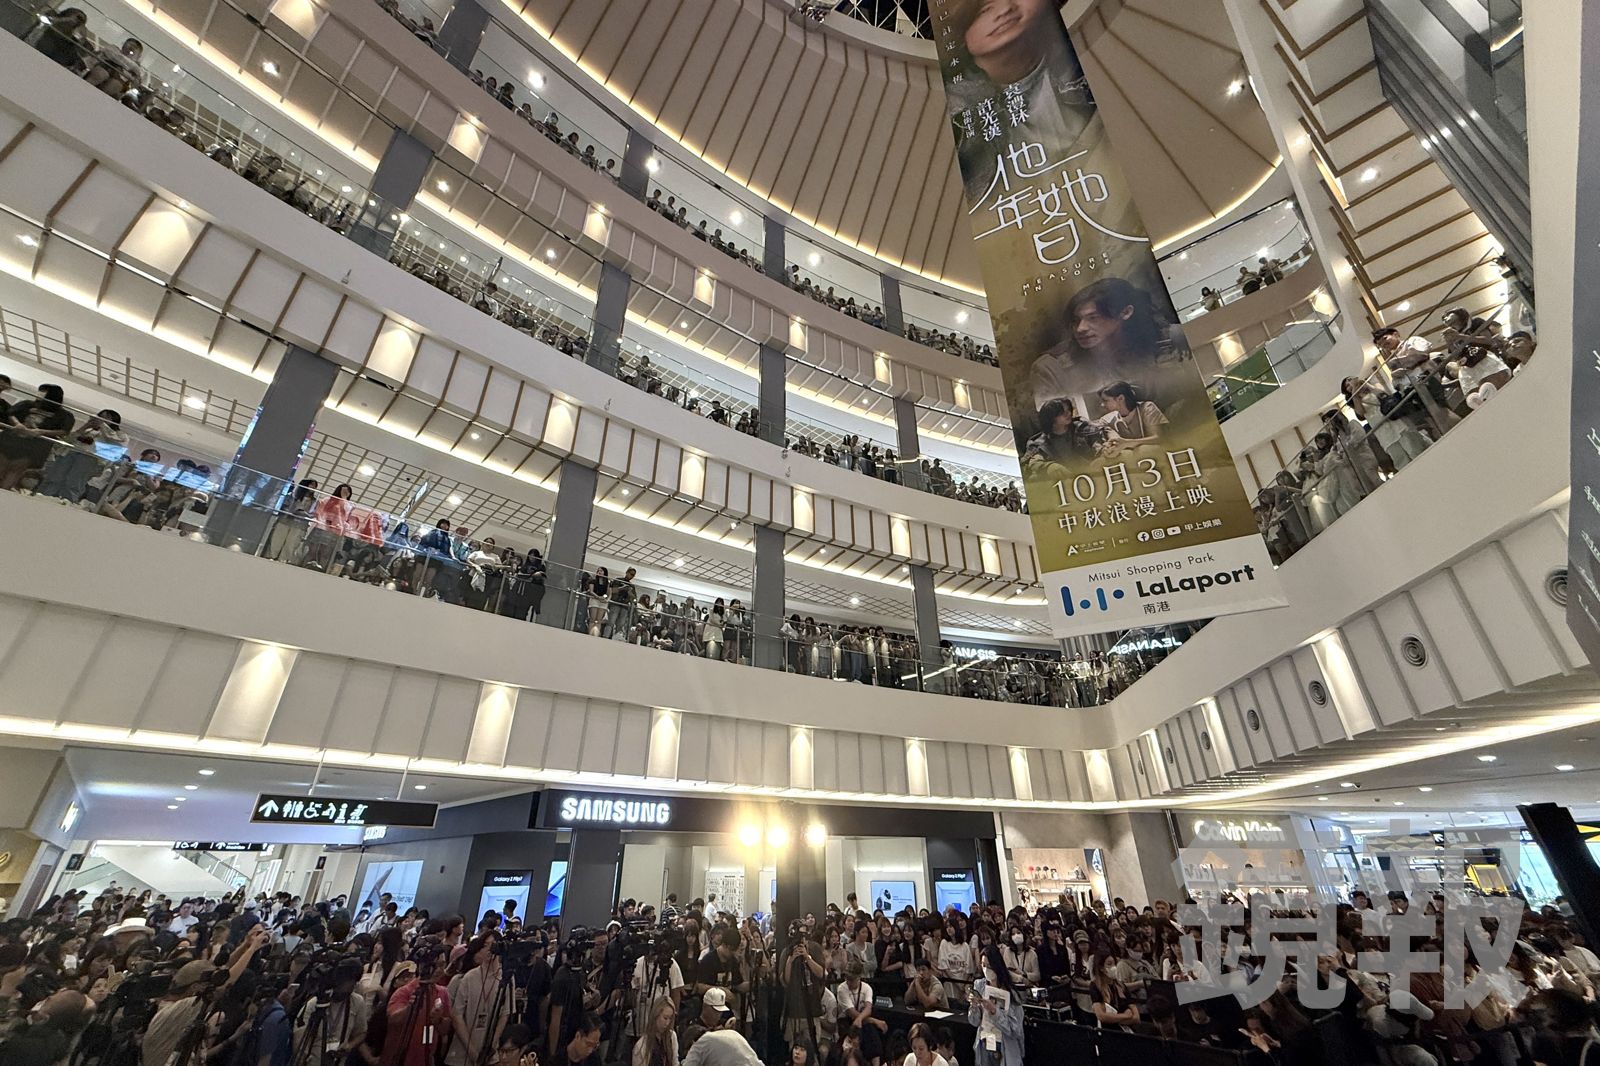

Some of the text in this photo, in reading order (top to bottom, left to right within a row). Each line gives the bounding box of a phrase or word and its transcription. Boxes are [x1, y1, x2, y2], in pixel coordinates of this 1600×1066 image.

[976, 97, 1002, 142] 許光漢
[1022, 252, 1109, 291] MEASURE
[1060, 258, 1110, 281] LOVE
[1053, 448, 1202, 507] 10月3日
[1059, 485, 1214, 534] 中秋浪漫上映
[1184, 518, 1222, 532] 甲上娛樂
[1088, 552, 1215, 583] Mitsui Shopping Park
[1135, 564, 1255, 598] LaLaport
[1142, 601, 1171, 615] 南港
[561, 797, 670, 824] SAMSUNG
[1194, 820, 1286, 842] Calvin Klein
